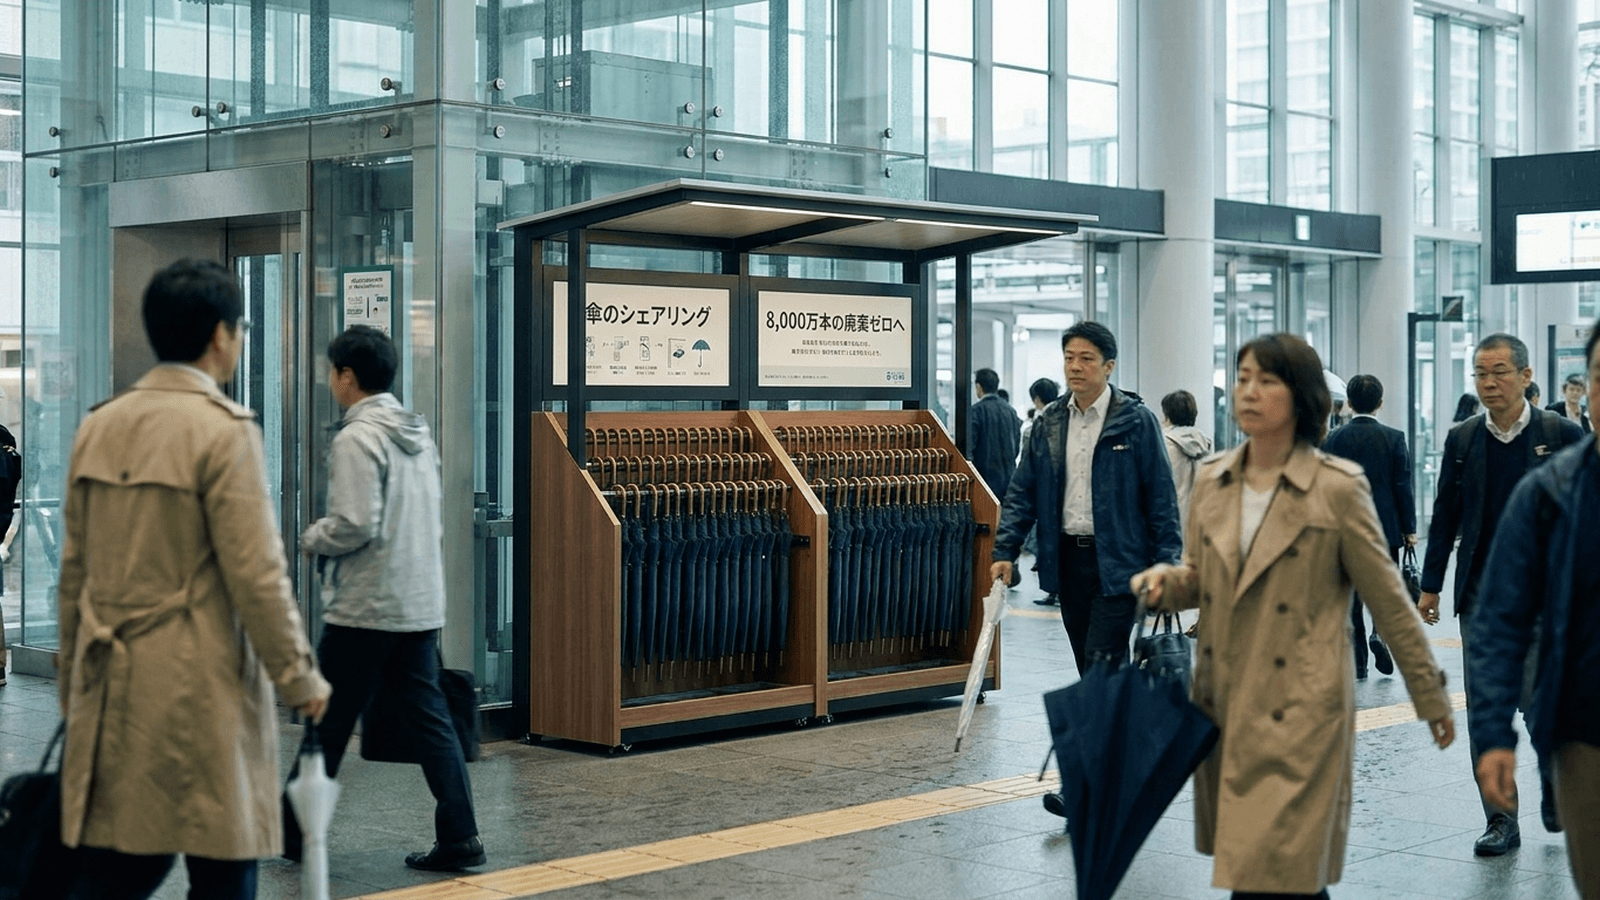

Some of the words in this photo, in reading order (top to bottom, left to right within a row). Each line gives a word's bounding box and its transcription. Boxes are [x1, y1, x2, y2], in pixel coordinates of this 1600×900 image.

[585, 302, 712, 328] 傘のシェアリング
[766, 310, 906, 333] 8,000万本の廃棄ゼロへ
